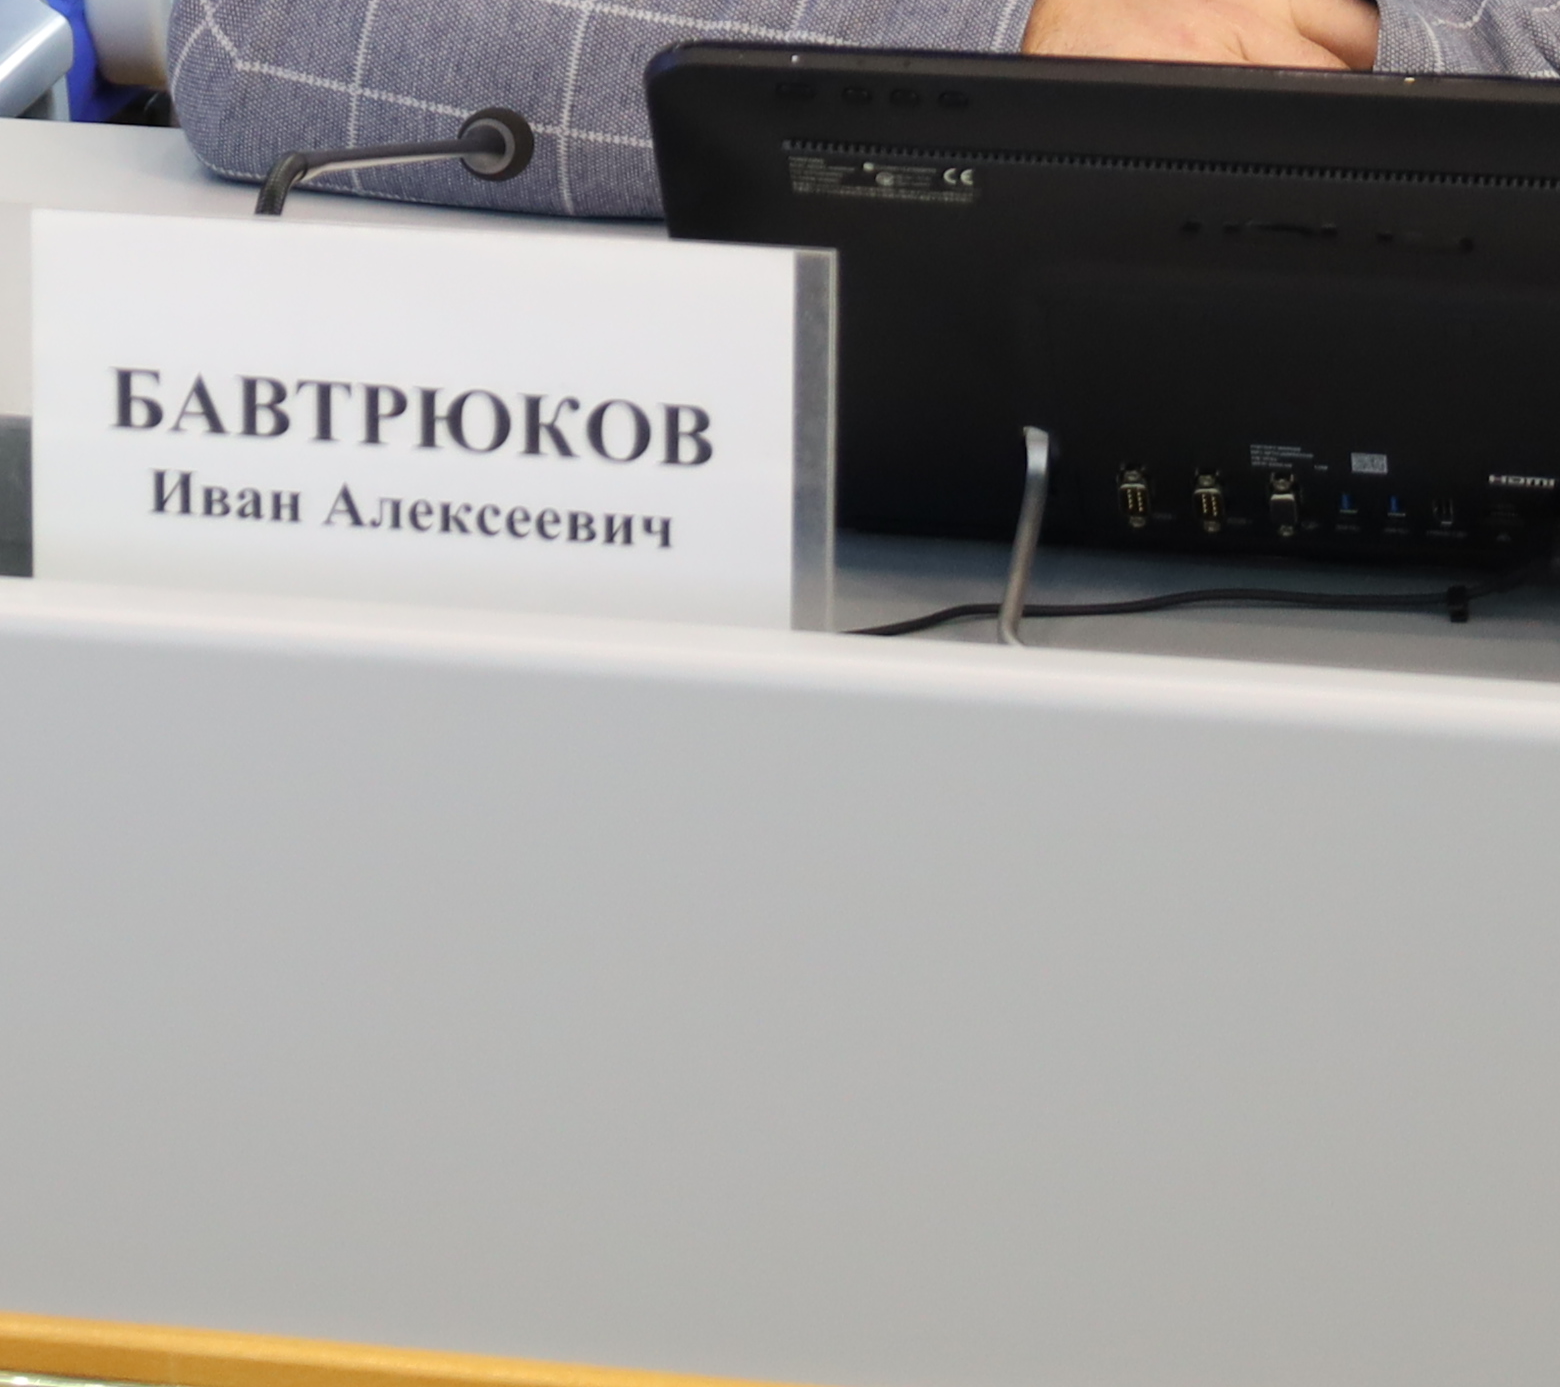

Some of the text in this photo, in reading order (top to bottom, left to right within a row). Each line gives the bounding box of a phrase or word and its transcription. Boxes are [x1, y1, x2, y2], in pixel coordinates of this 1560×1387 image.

[111, 367, 717, 468] БАВТРЮКОВ
[149, 468, 675, 551] Иван Алексеевич
